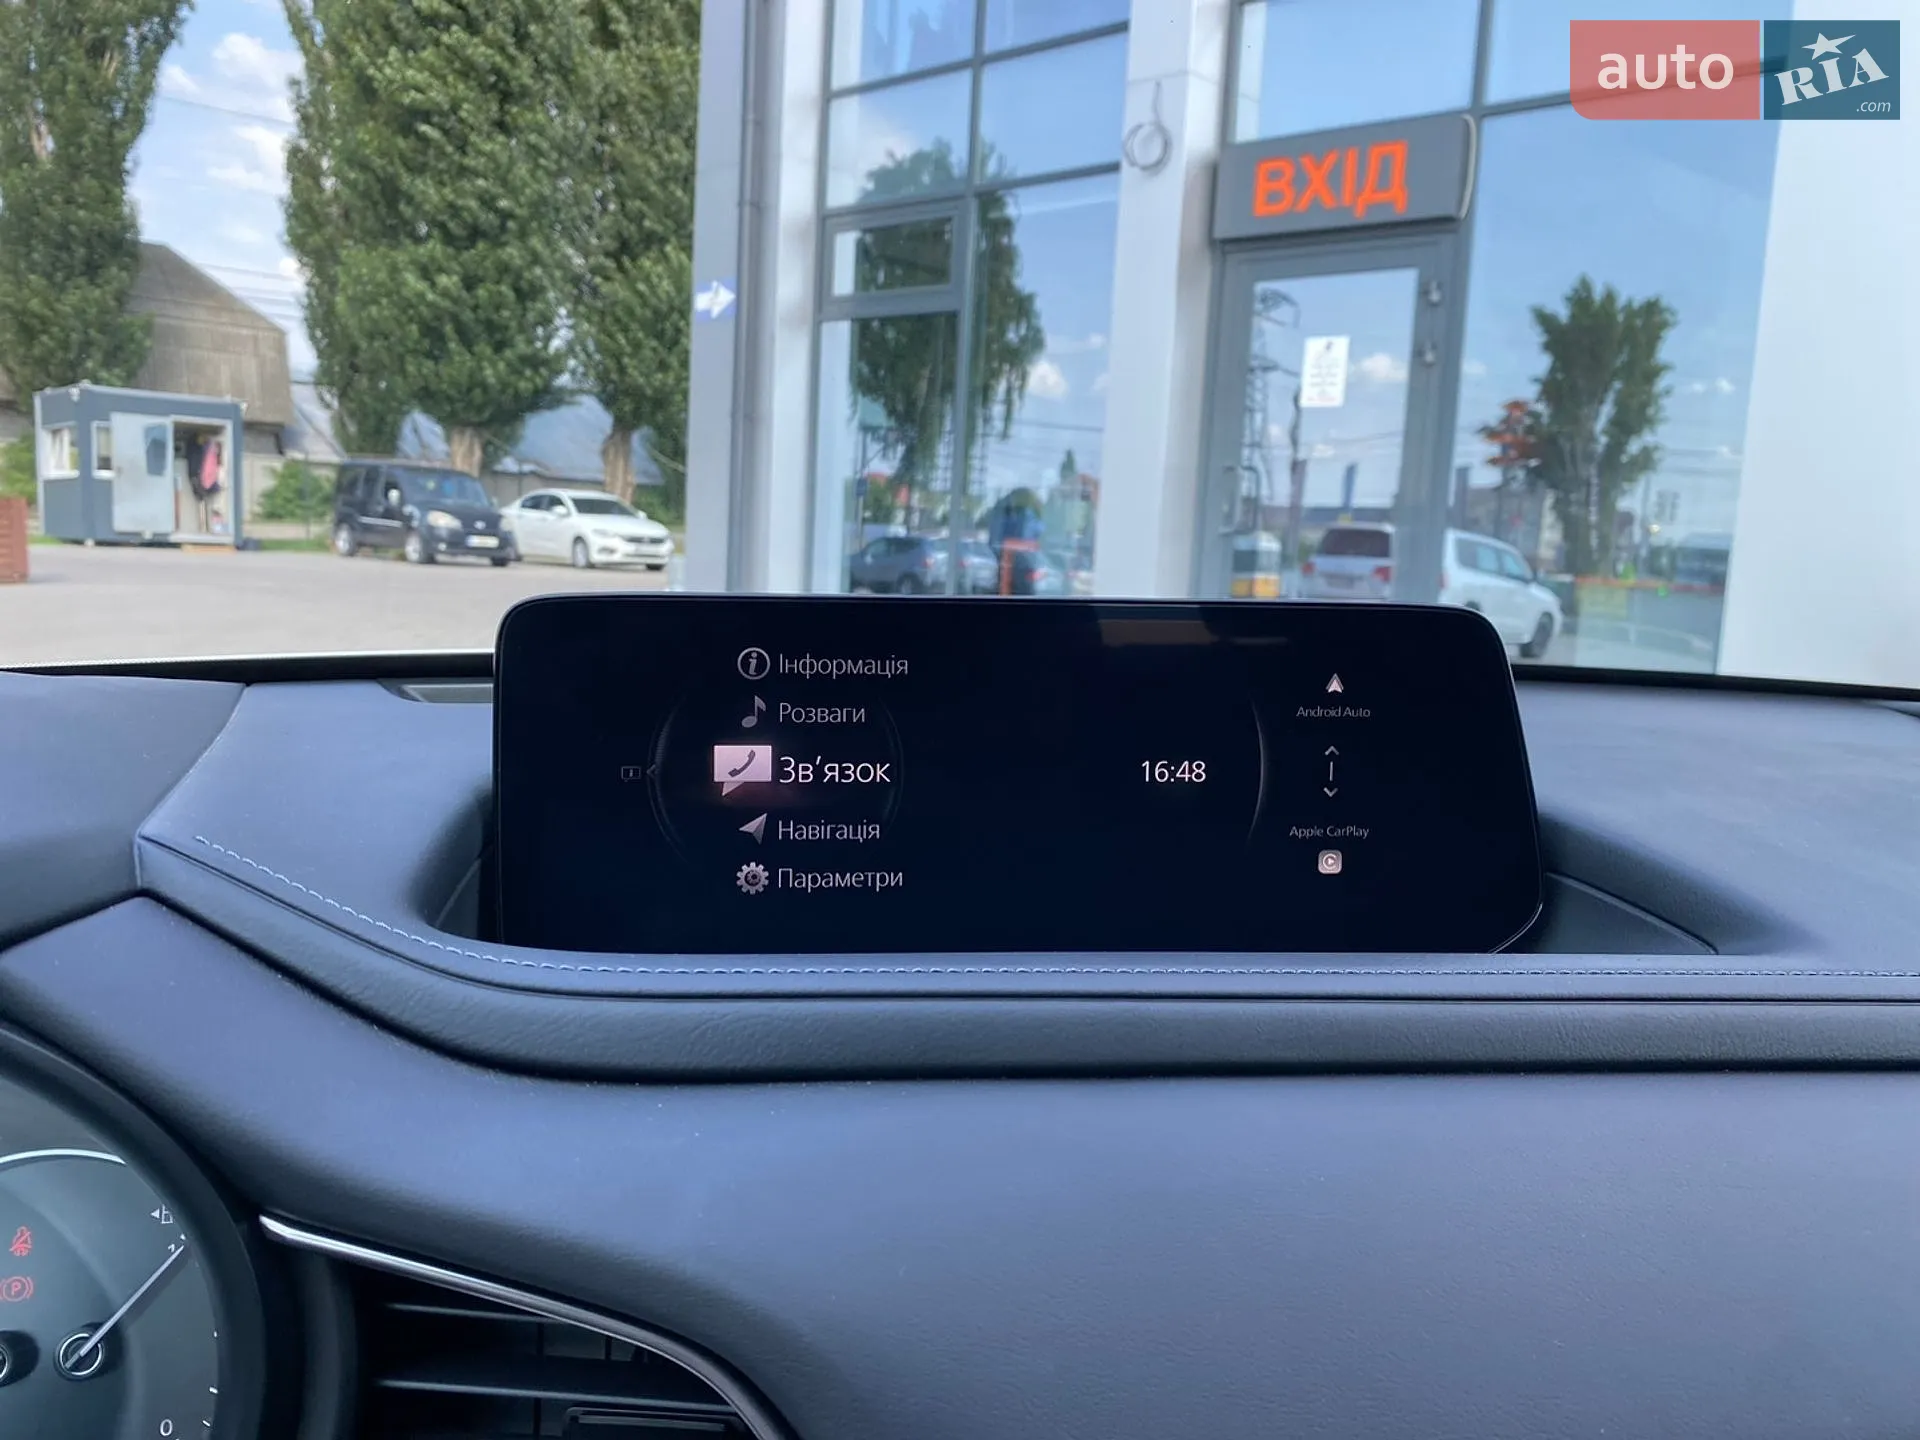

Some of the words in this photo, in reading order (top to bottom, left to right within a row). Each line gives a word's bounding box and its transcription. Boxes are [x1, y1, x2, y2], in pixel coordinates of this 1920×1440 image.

[1254, 139, 1408, 219] ВХІД
[780, 653, 908, 679] Інформація
[780, 703, 864, 722] Розваги
[1296, 705, 1341, 717] Android
[1342, 706, 1371, 717] Auto
[1142, 760, 1206, 782] 16:48
[779, 820, 879, 843] Навігація
[1289, 825, 1323, 839] Apple
[1326, 825, 1370, 839] CarPlay
[779, 868, 902, 893] Параметри
